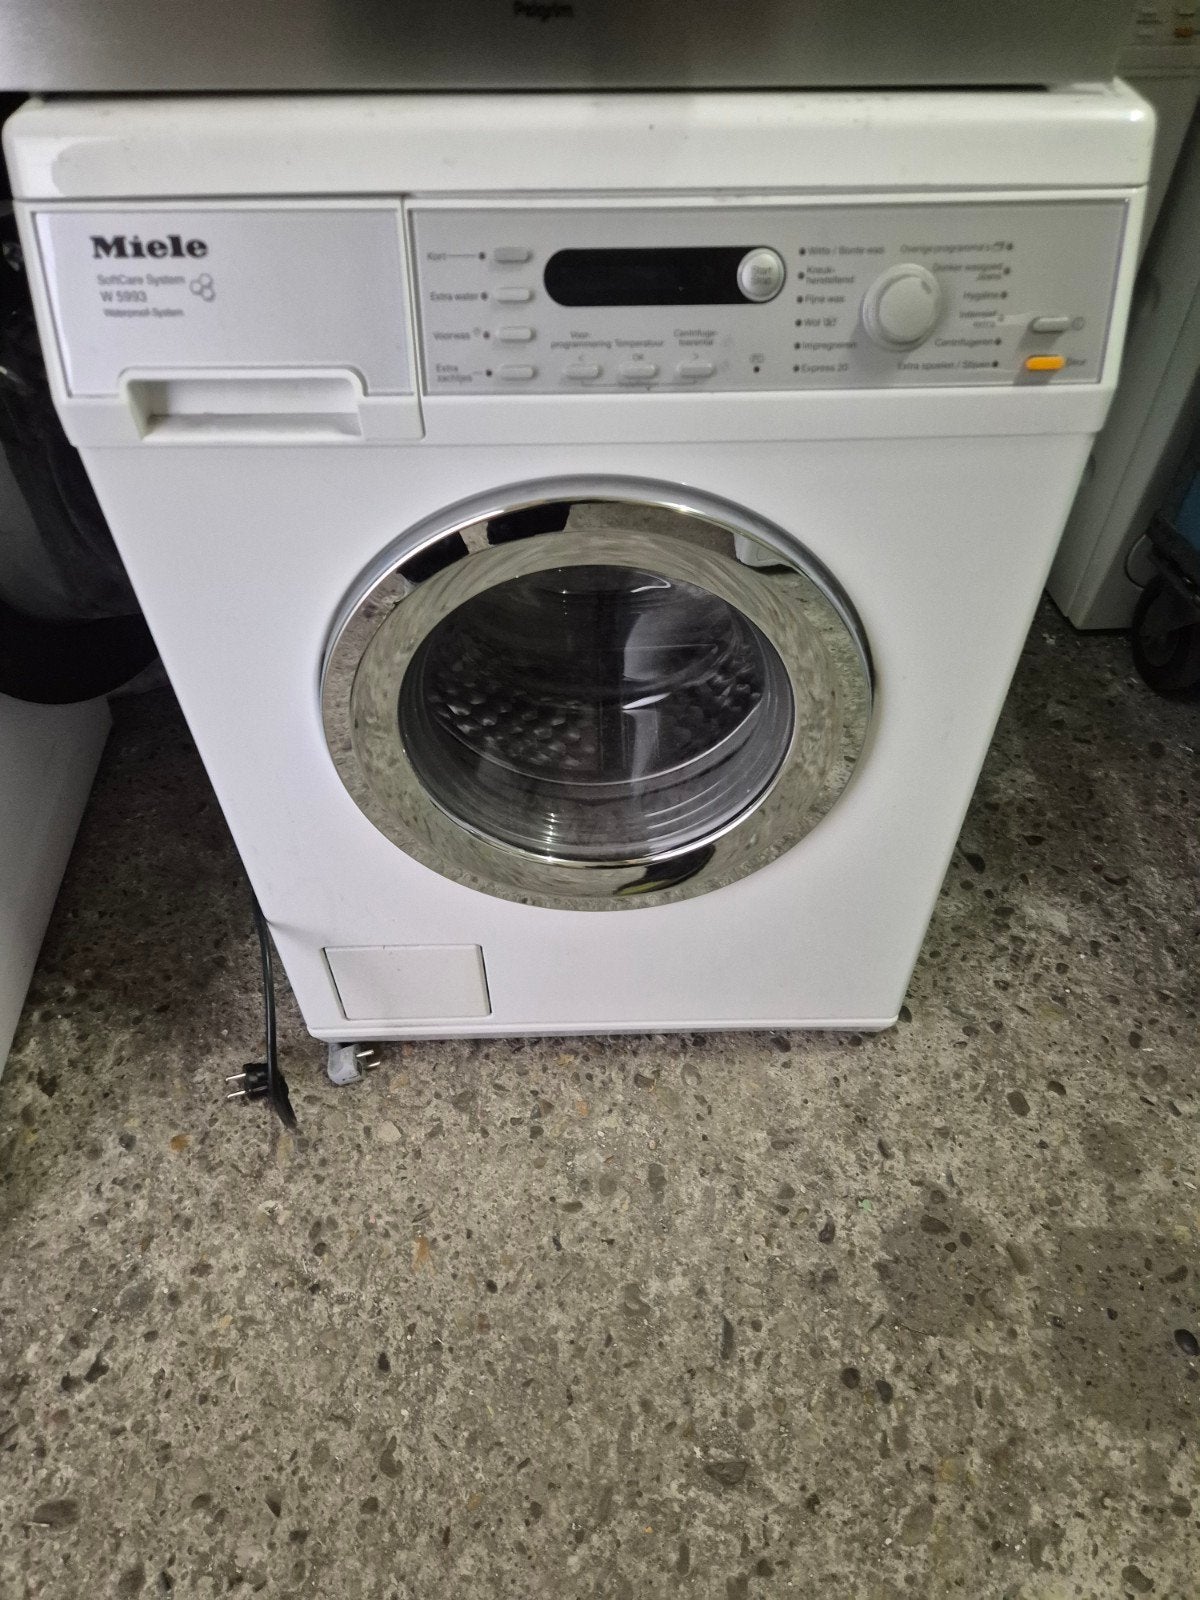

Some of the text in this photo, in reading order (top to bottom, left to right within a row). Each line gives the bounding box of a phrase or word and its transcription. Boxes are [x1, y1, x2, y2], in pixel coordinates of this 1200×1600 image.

[90, 234, 209, 259] Miele
[146, 273, 185, 287] System
[100, 290, 114, 302] W
